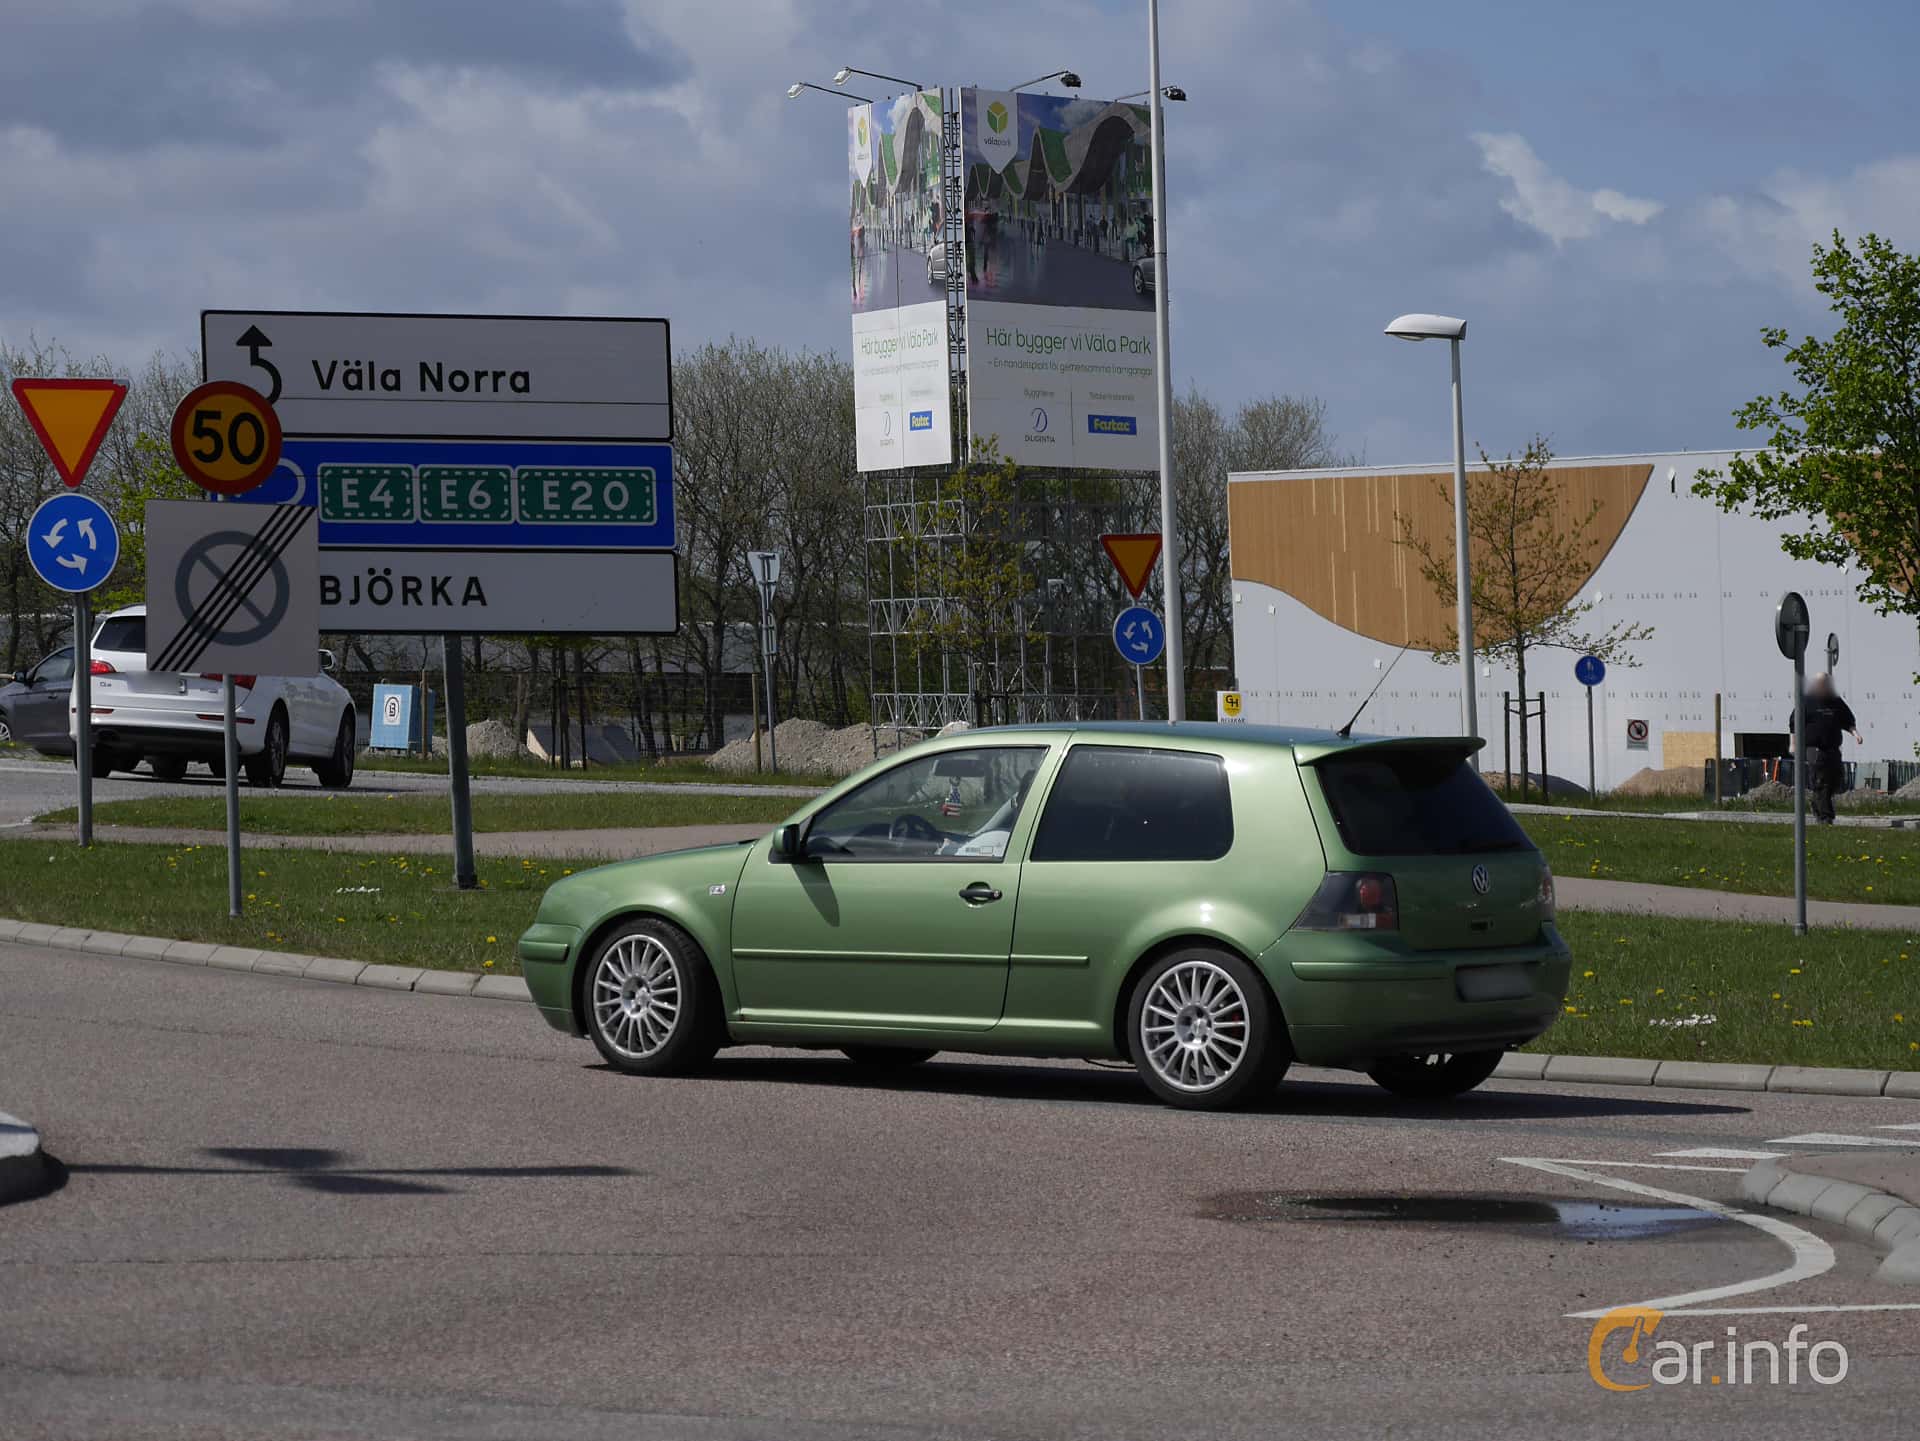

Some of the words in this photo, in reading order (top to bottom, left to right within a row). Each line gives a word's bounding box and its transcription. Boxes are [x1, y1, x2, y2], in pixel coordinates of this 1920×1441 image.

[986, 327, 1012, 346] Här
[1016, 328, 1067, 355] bygger
[1071, 333, 1082, 351] vi
[1084, 333, 1117, 353] Väla
[1120, 335, 1152, 356] Park
[311, 359, 401, 392] Väla
[419, 361, 531, 394] Norra
[190, 409, 265, 465] 50
[341, 479, 394, 509] E4
[440, 479, 492, 510] E6
[541, 480, 630, 511] E20
[320, 567, 488, 607] BJÖRKA
